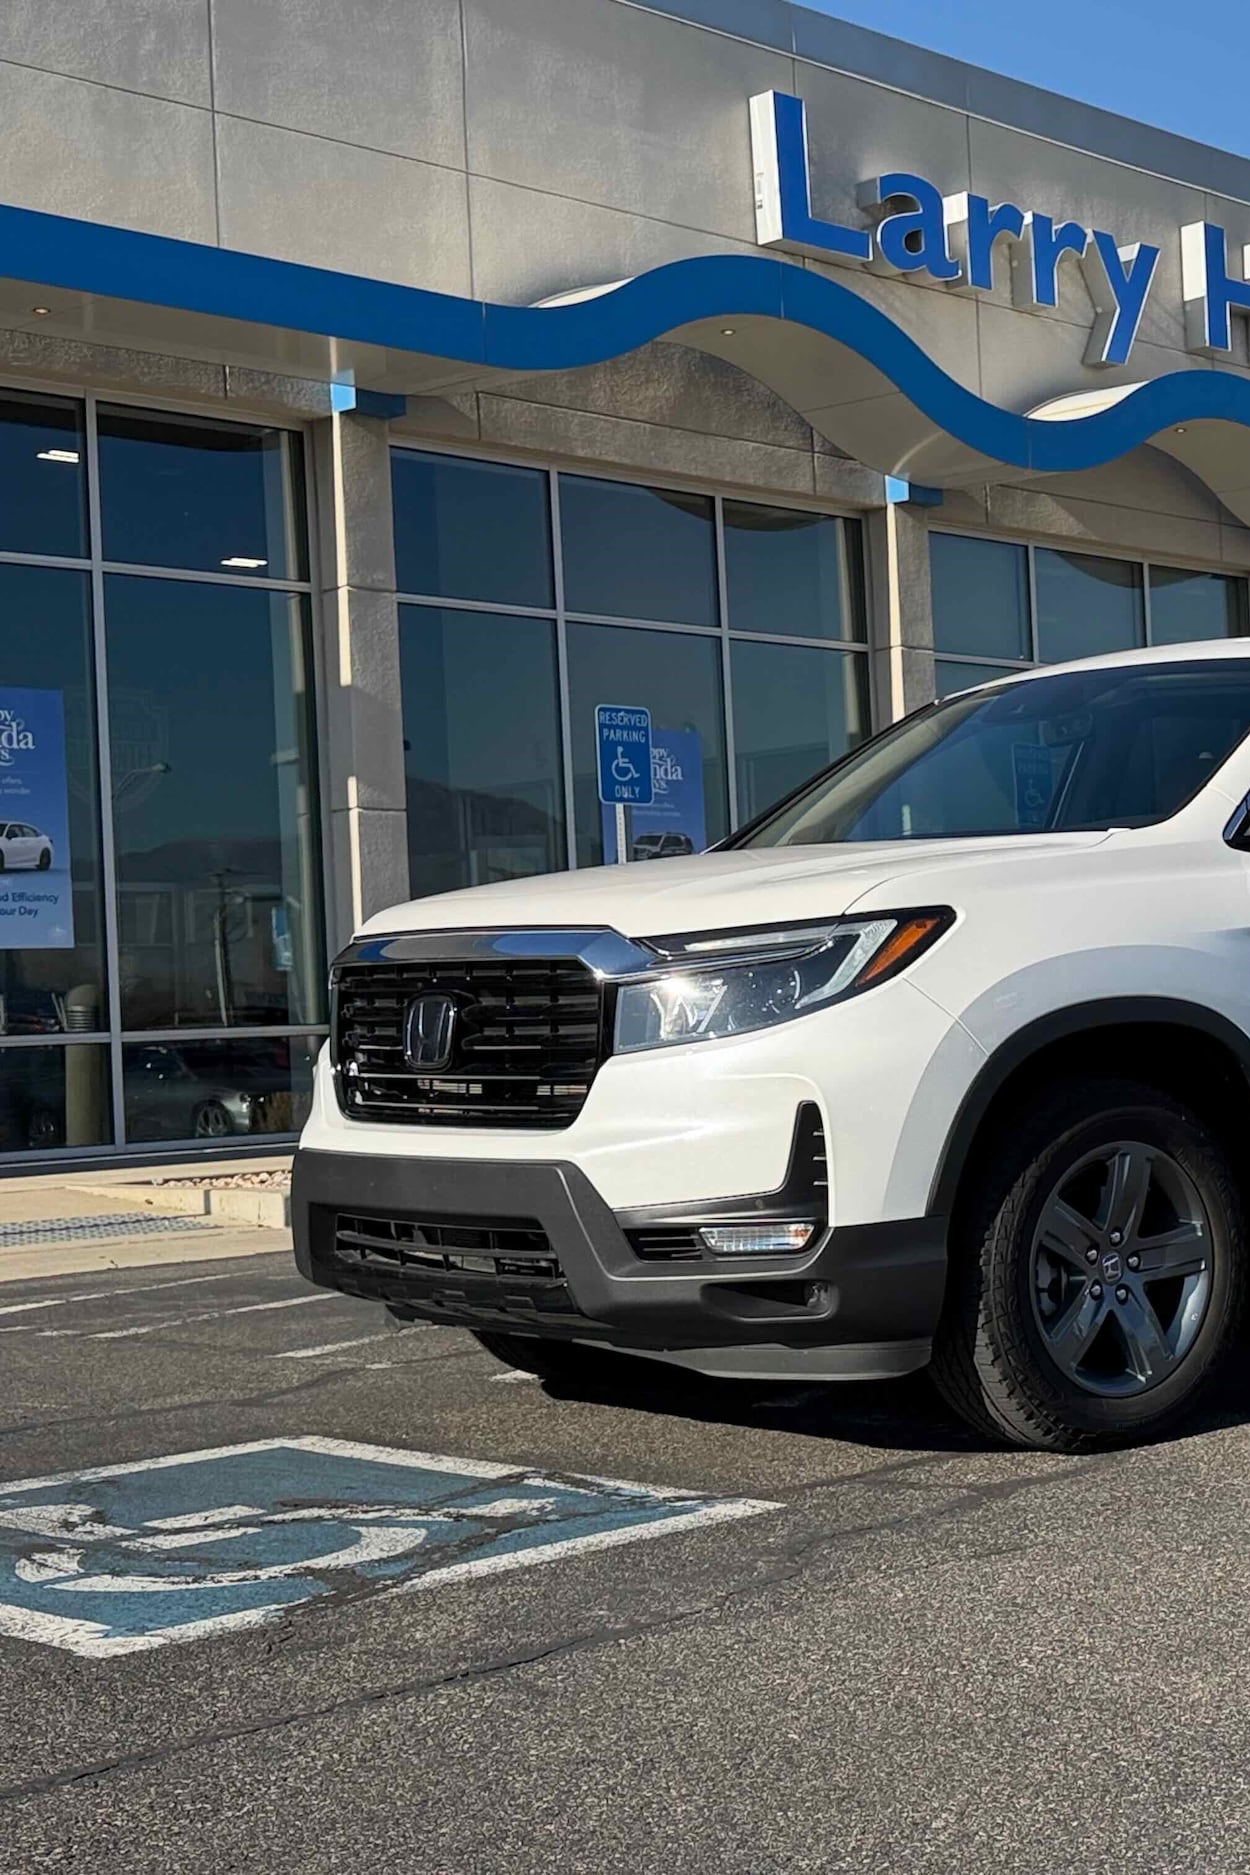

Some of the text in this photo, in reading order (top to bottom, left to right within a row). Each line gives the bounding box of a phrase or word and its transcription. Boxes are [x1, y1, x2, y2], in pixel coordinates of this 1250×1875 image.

[749, 89, 1160, 366] Larry
[599, 711, 647, 726] RESERVED
[603, 728, 645, 743] PARKING
[615, 785, 640, 799] ONLY
[12, 892, 60, 906] Efficiency
[19, 905, 39, 918] Day
